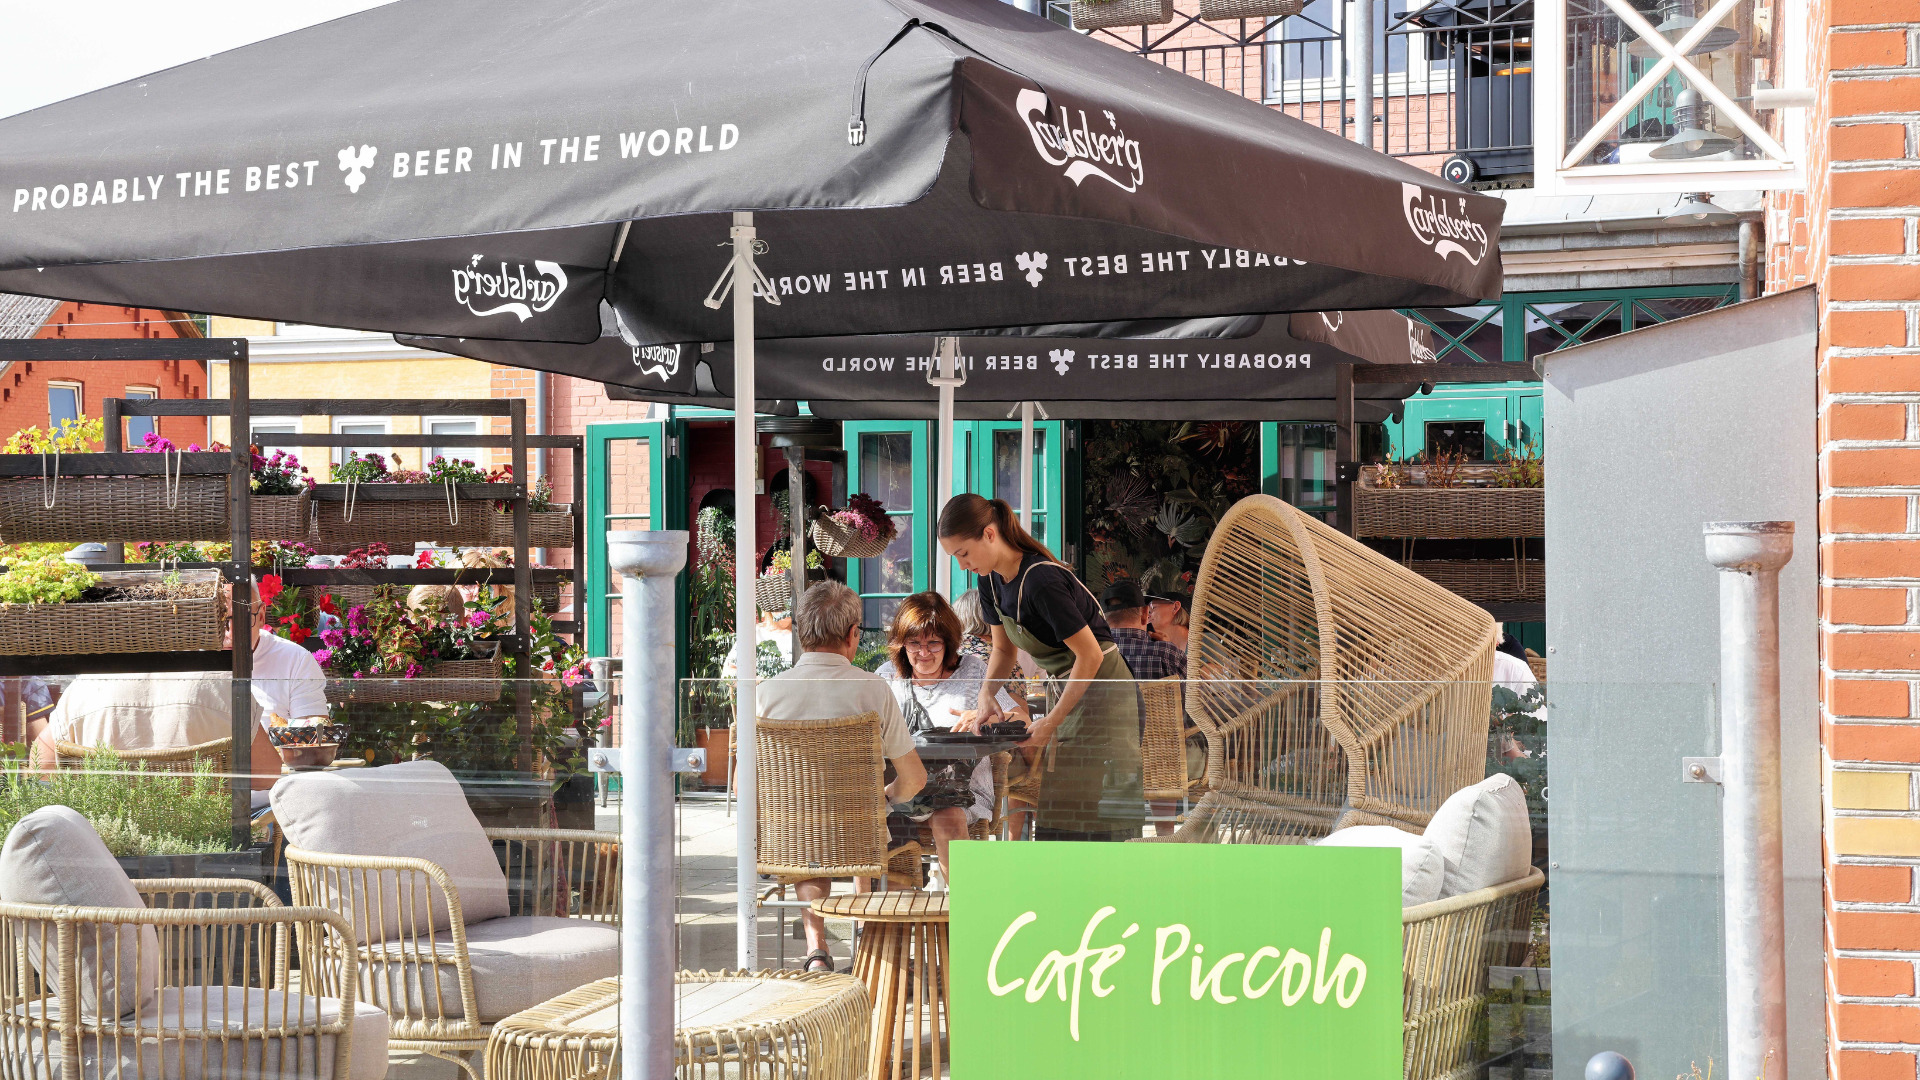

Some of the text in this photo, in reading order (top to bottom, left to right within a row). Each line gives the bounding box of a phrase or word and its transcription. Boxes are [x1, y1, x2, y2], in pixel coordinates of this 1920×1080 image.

[12, 123, 740, 213] PROBABLY THE BEST BEER IN THE WORLD
[1016, 88, 1144, 193] Carlsberg
[1402, 181, 1488, 266] Carlsberg
[987, 905, 1368, 1042] Café Piccolo
